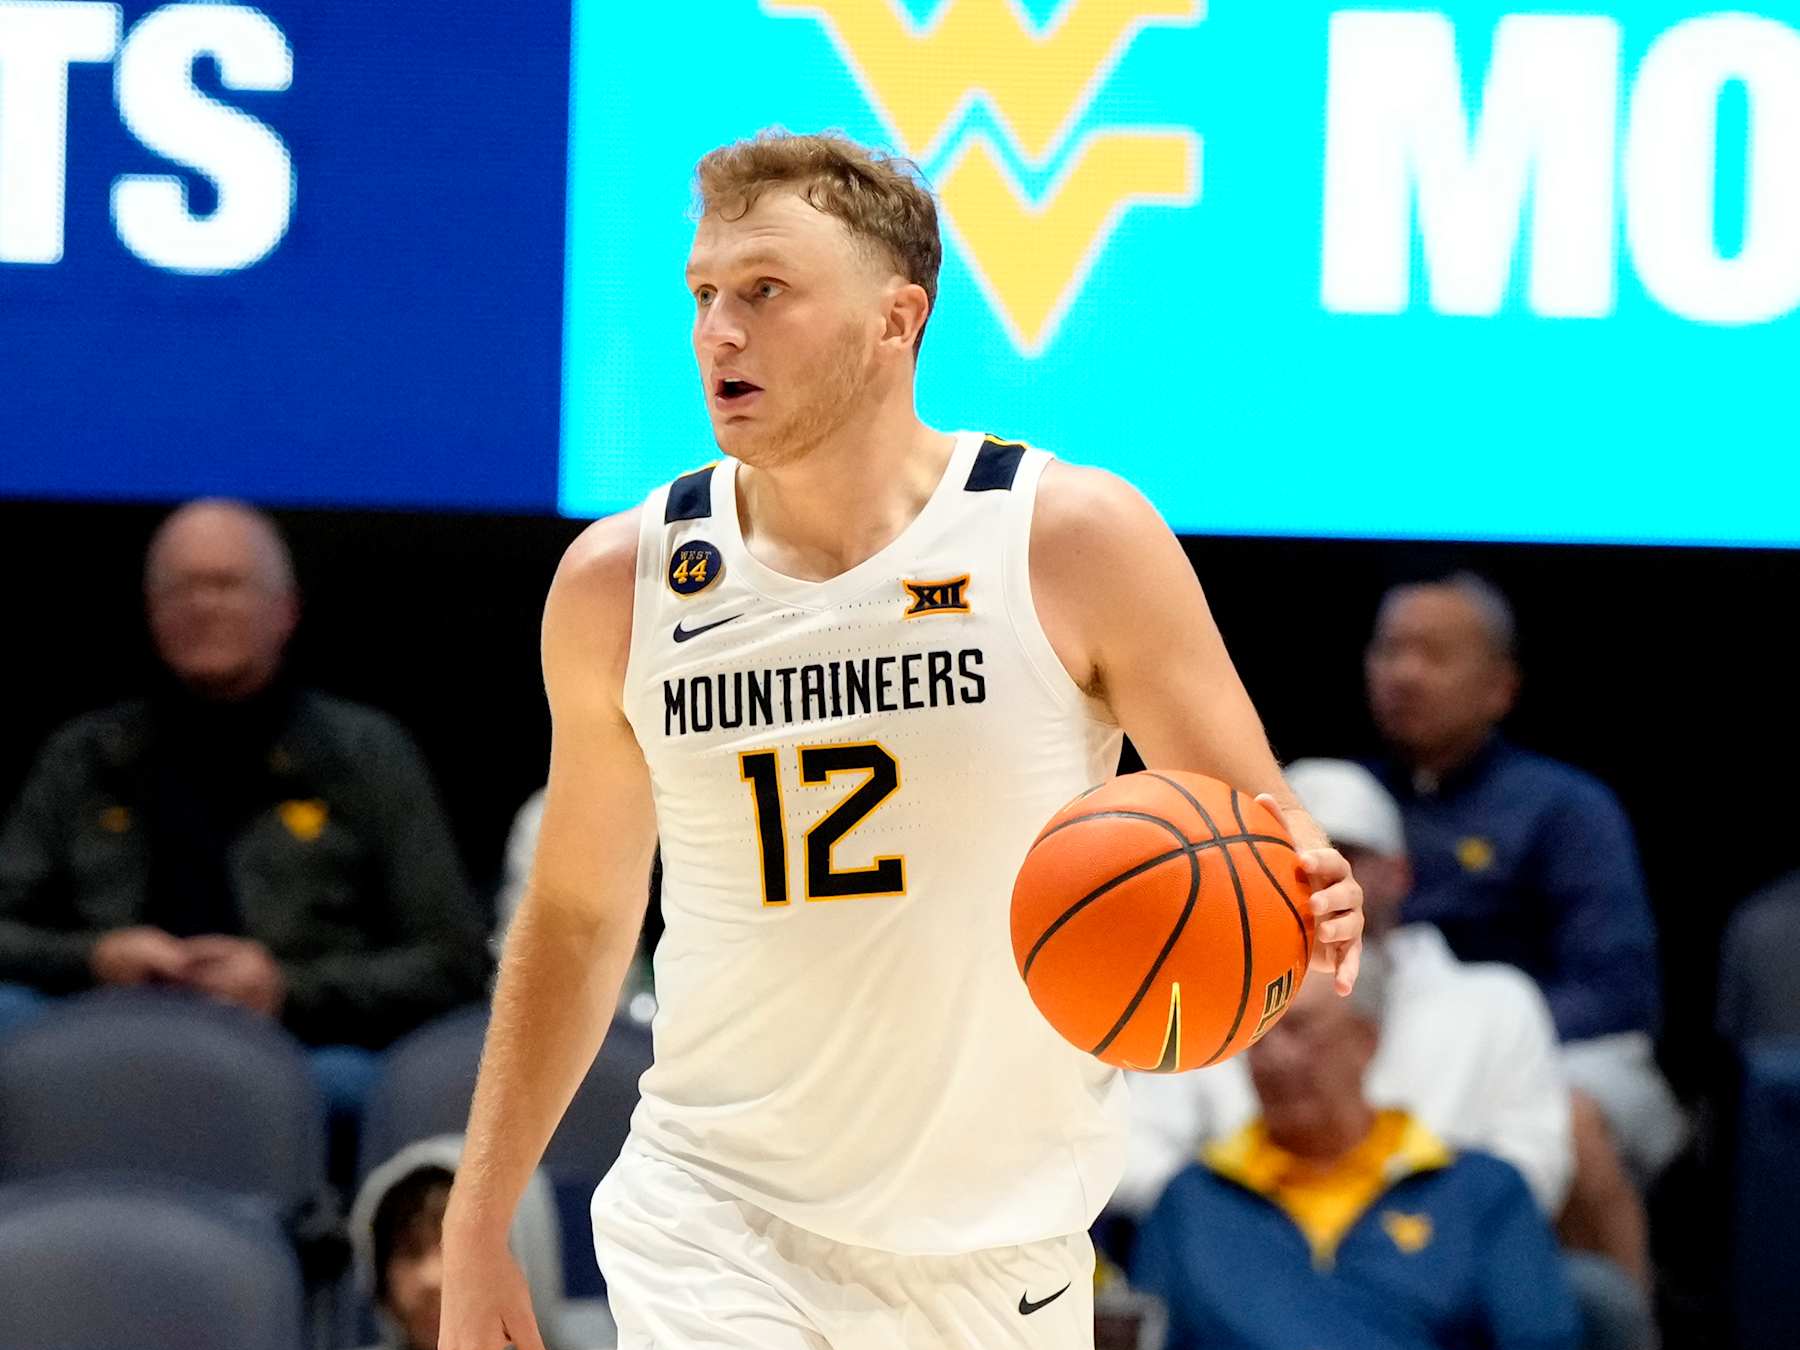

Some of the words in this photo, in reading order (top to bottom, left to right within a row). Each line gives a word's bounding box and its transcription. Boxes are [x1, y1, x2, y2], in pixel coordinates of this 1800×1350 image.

[1319, 9, 1800, 325] MO
[672, 559, 708, 585] 44
[664, 648, 986, 736] MOUNTAINEERS
[737, 740, 907, 907] 12
